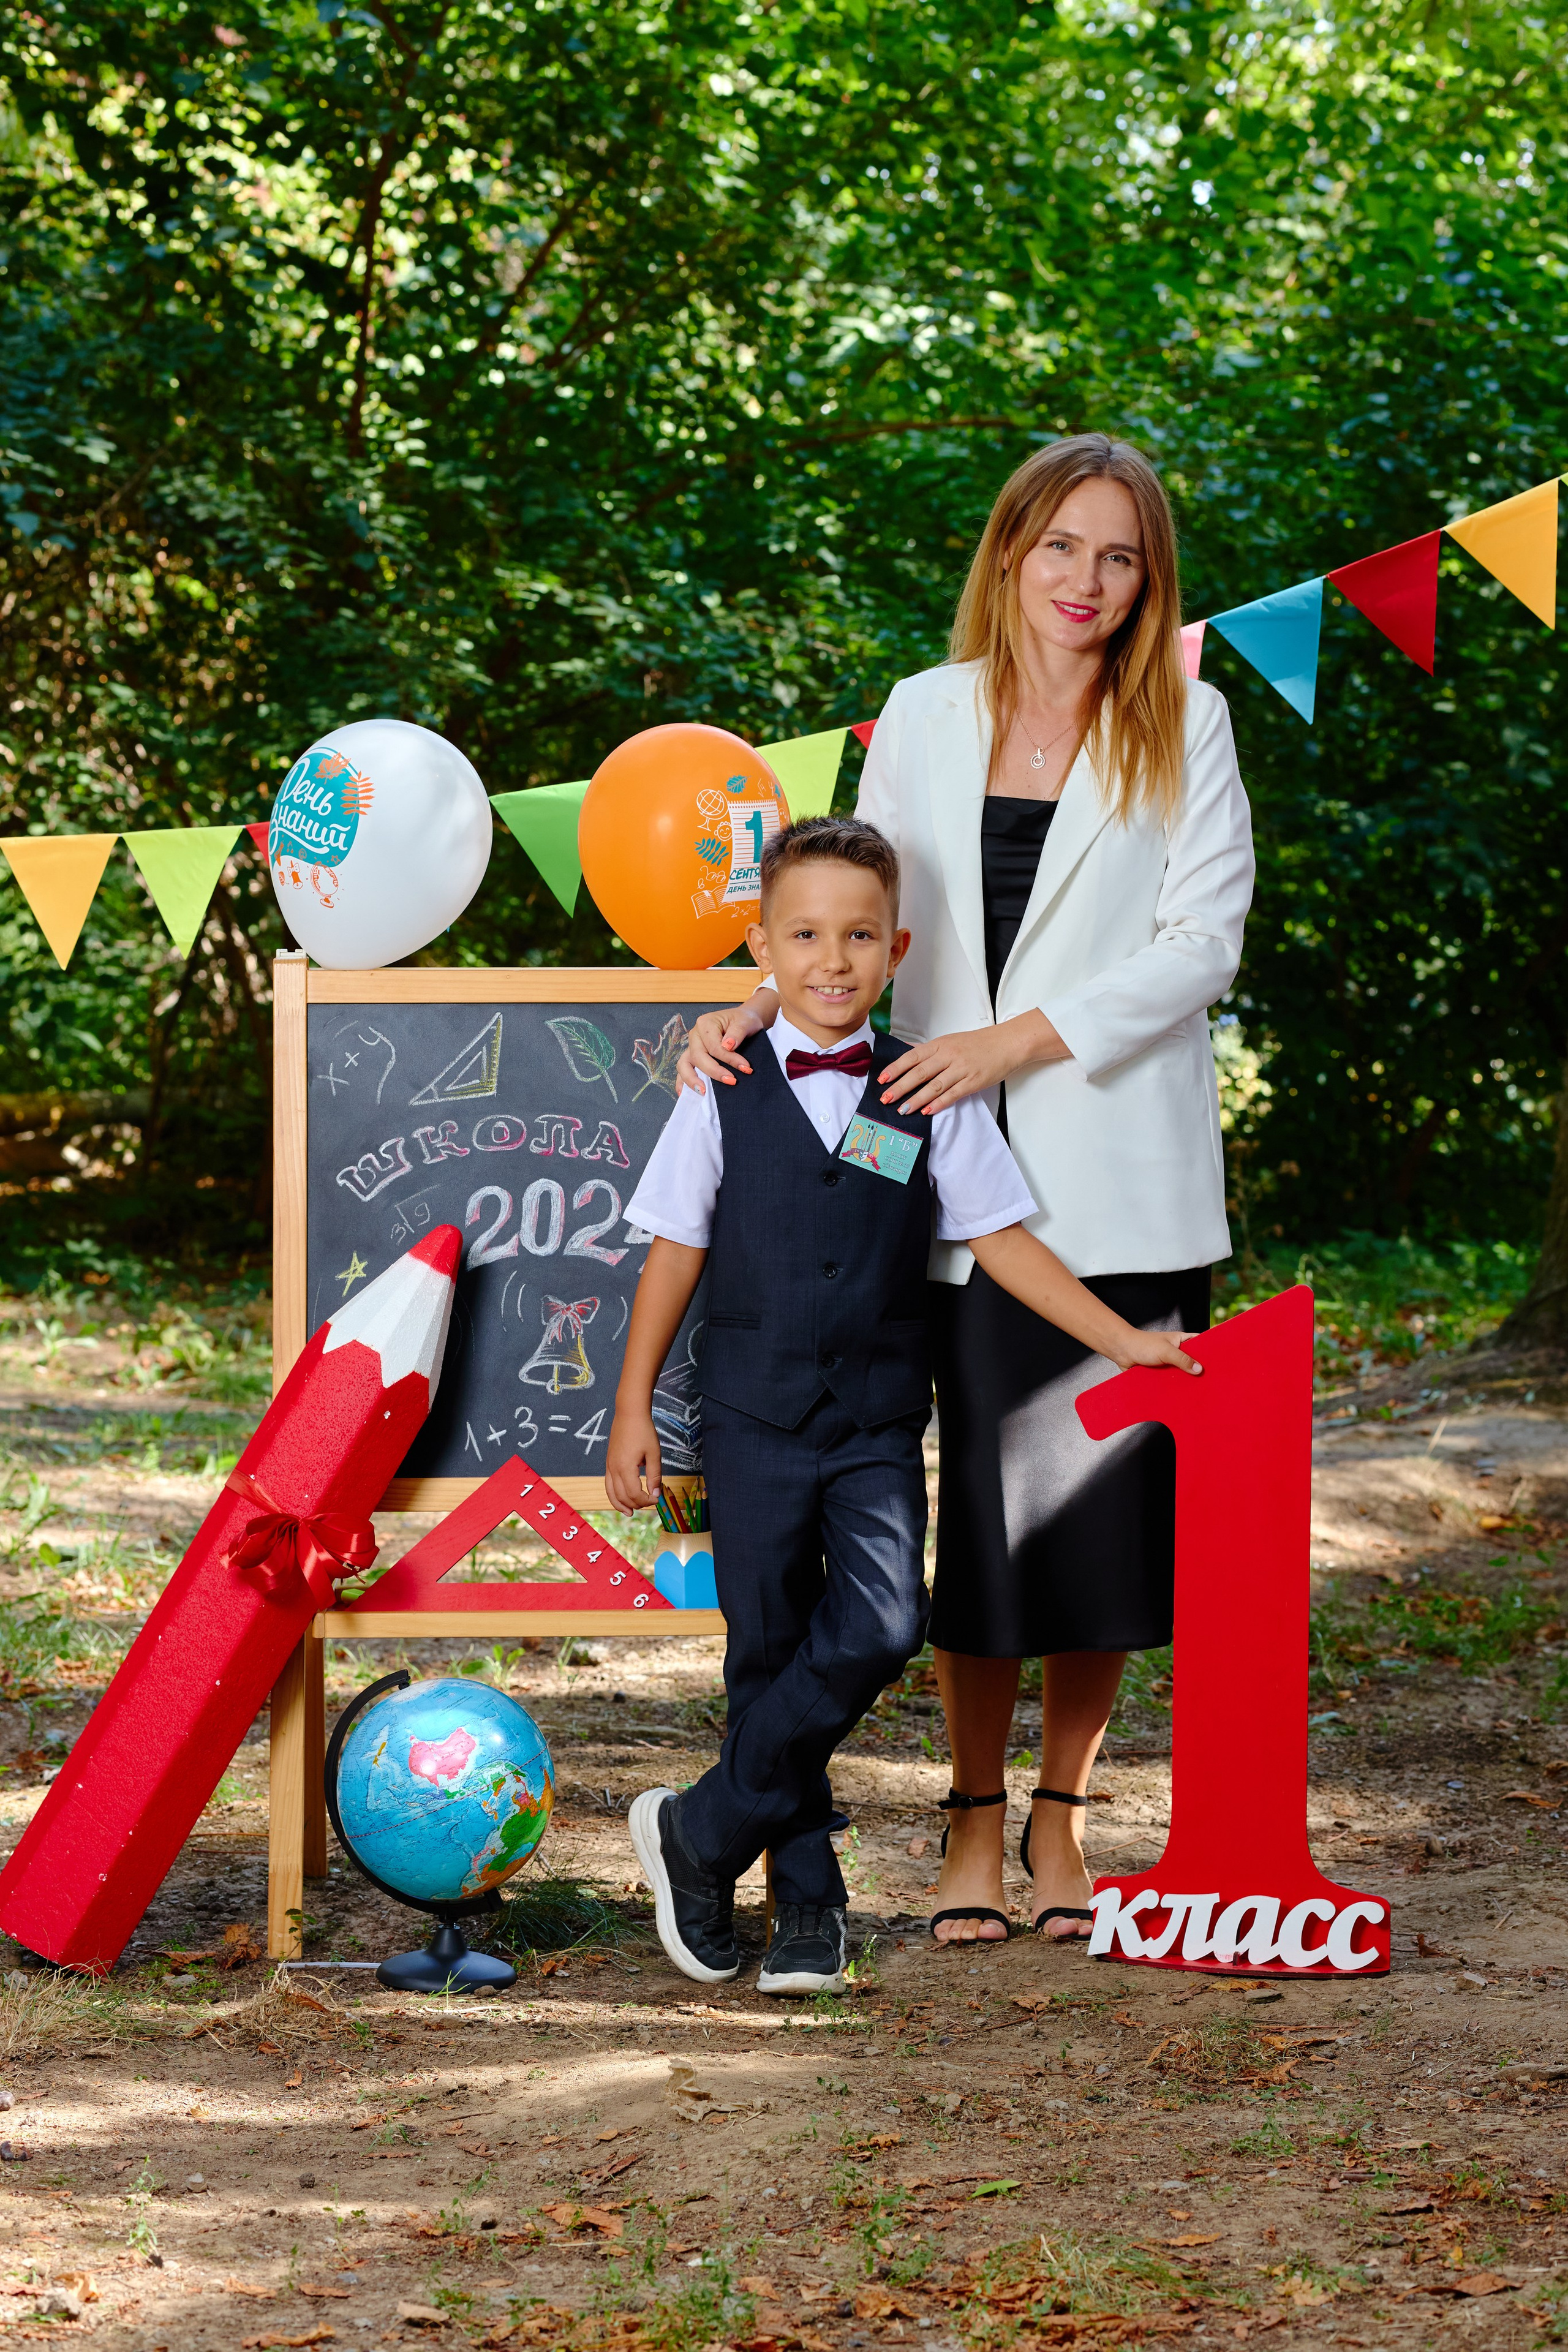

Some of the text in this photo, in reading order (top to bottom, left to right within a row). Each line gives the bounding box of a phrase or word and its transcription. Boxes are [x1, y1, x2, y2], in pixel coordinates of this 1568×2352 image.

[282, 757, 334, 816] День
[270, 803, 351, 855] знаний
[745, 811, 763, 864] 1
[726, 885, 747, 894] ДЕНЬ
[729, 867, 761, 880] СЕНТЯ
[336, 1114, 630, 1202] ШКОЛА
[889, 1135, 895, 1145] 1
[519, 1483, 649, 1608] 1 2 3 4 5 6
[1087, 1887, 1385, 1970] класс
